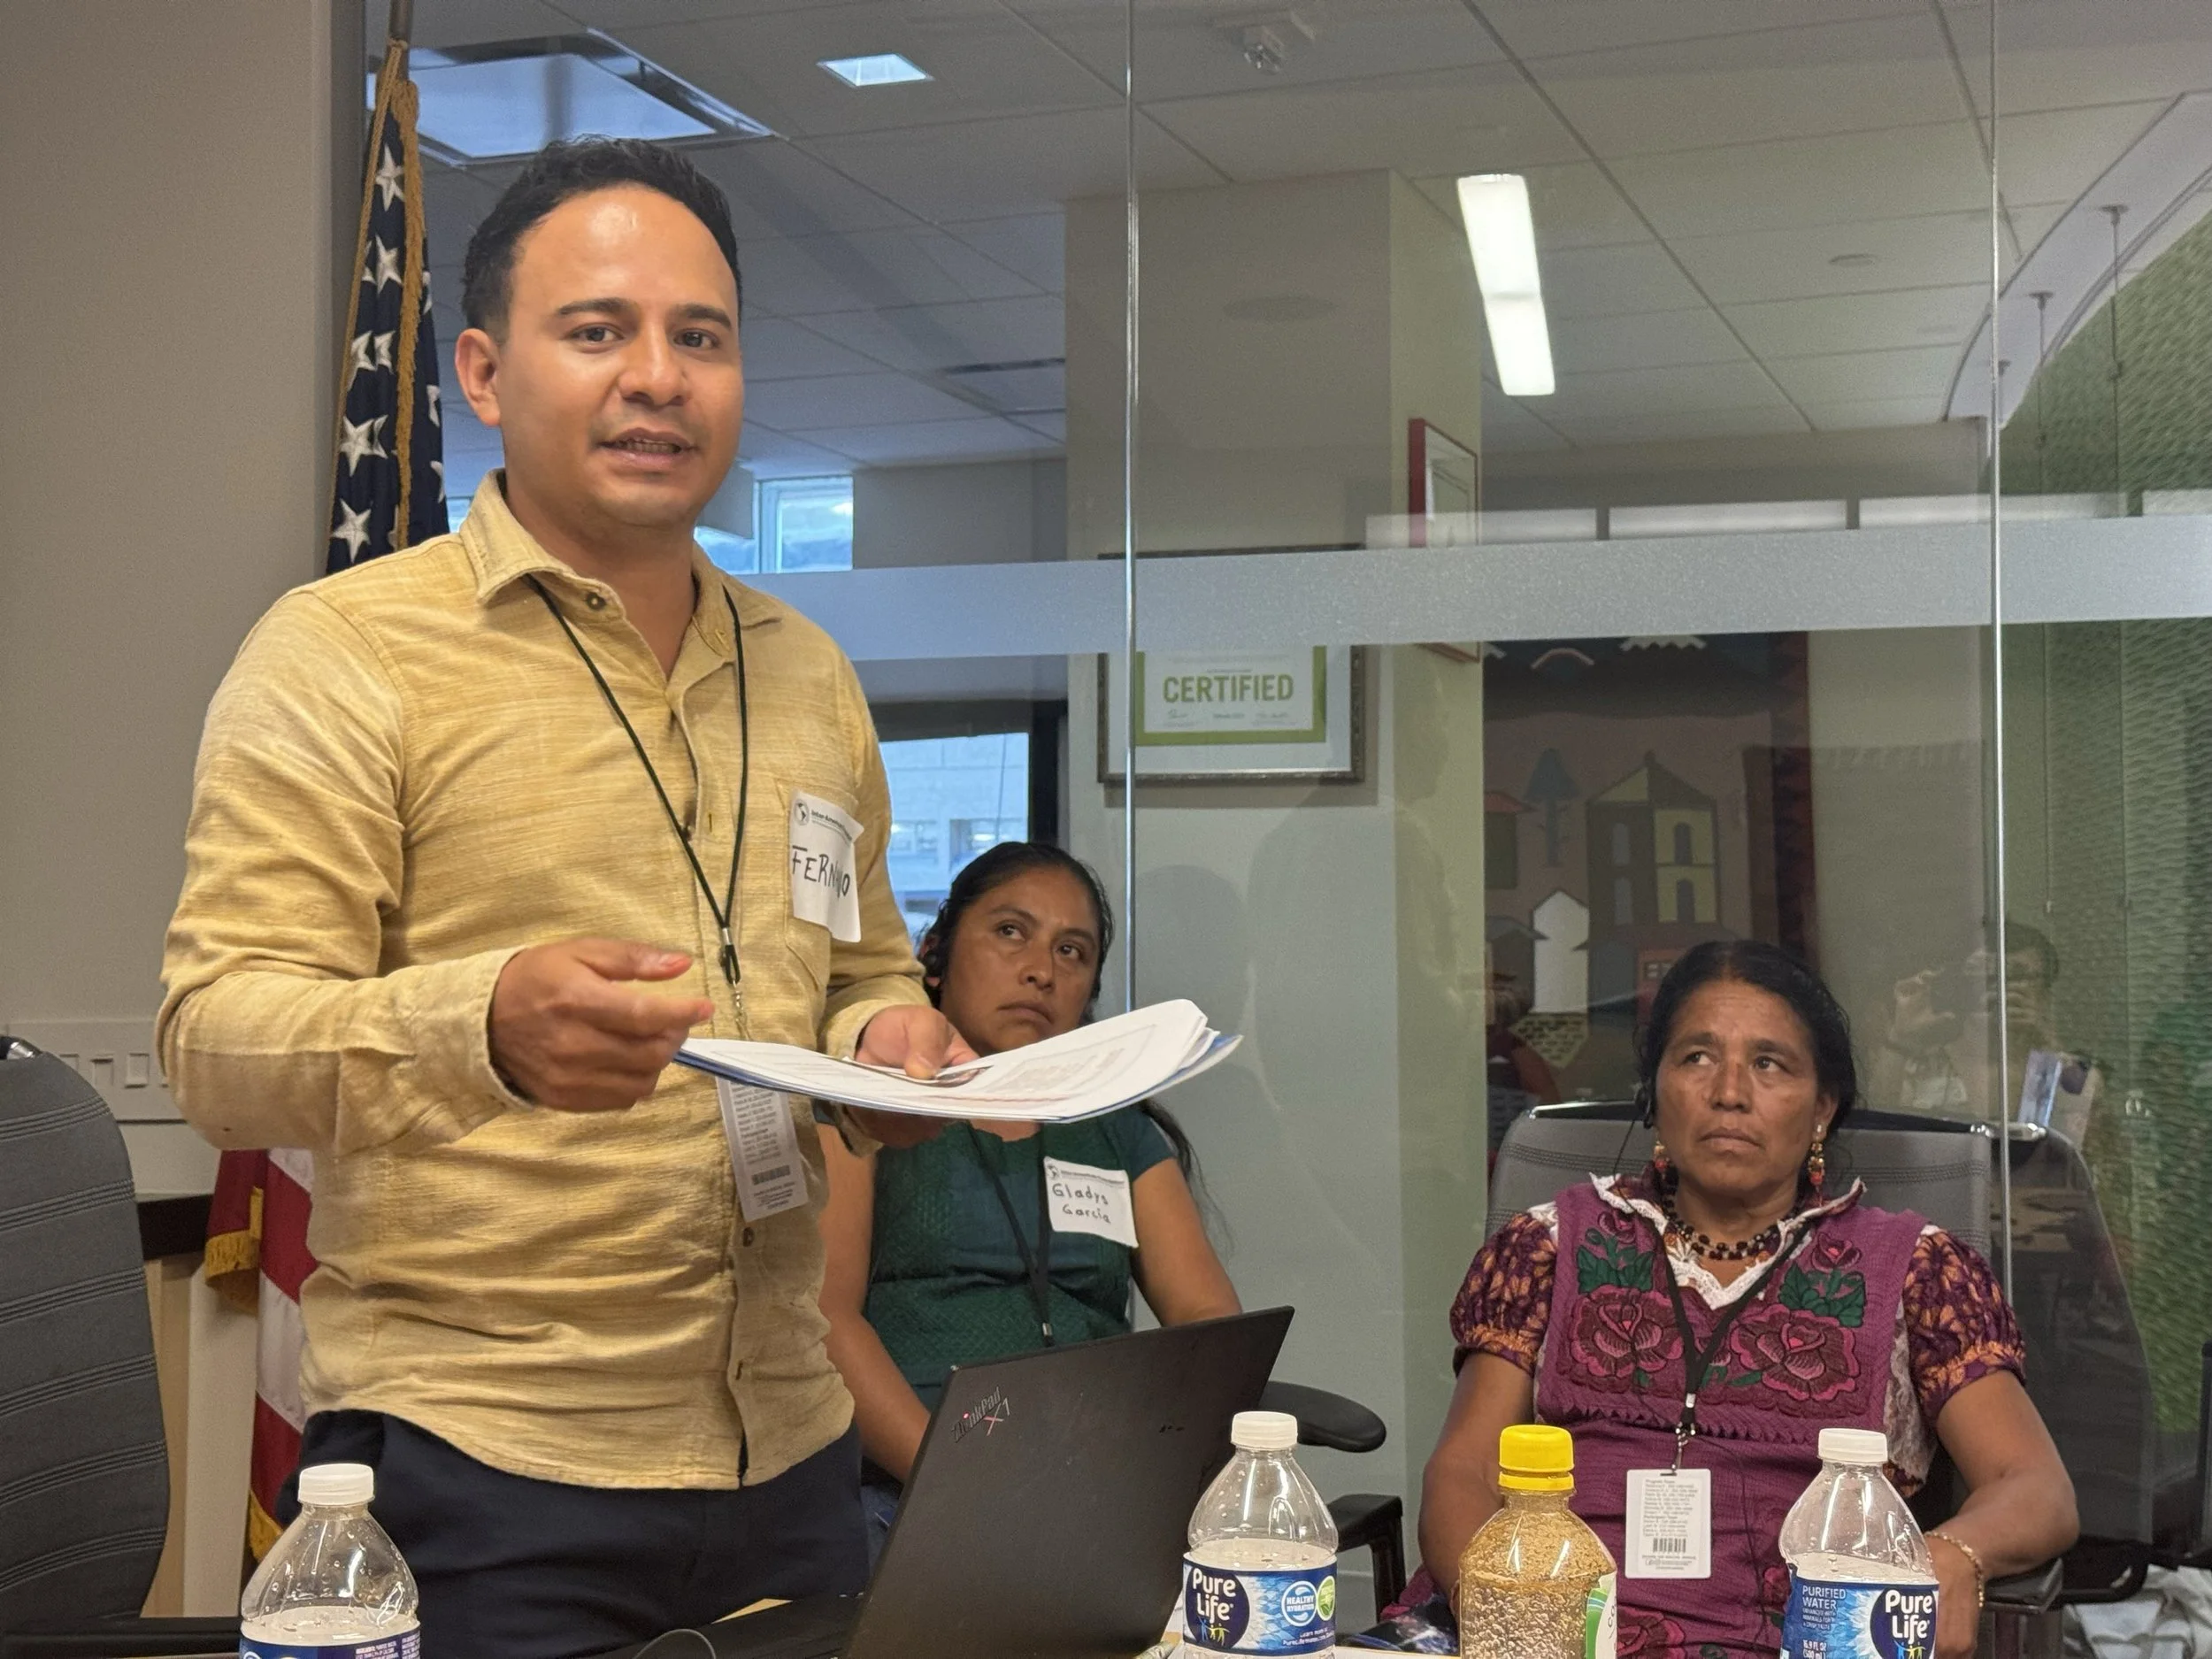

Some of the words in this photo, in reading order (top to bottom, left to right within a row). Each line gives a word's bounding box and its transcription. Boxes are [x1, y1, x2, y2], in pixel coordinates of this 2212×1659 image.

[1163, 674, 1294, 703] CERTIFIED
[1052, 1183, 1109, 1205] Gladys
[1193, 1568, 1237, 1598] Pure
[1802, 1585, 1847, 1600] PURIFIED
[1196, 1593, 1231, 1624] Life
[1802, 1596, 1837, 1609] WATER
[1886, 1589, 1933, 1615] Pure
[1892, 1615, 1928, 1645] Life
